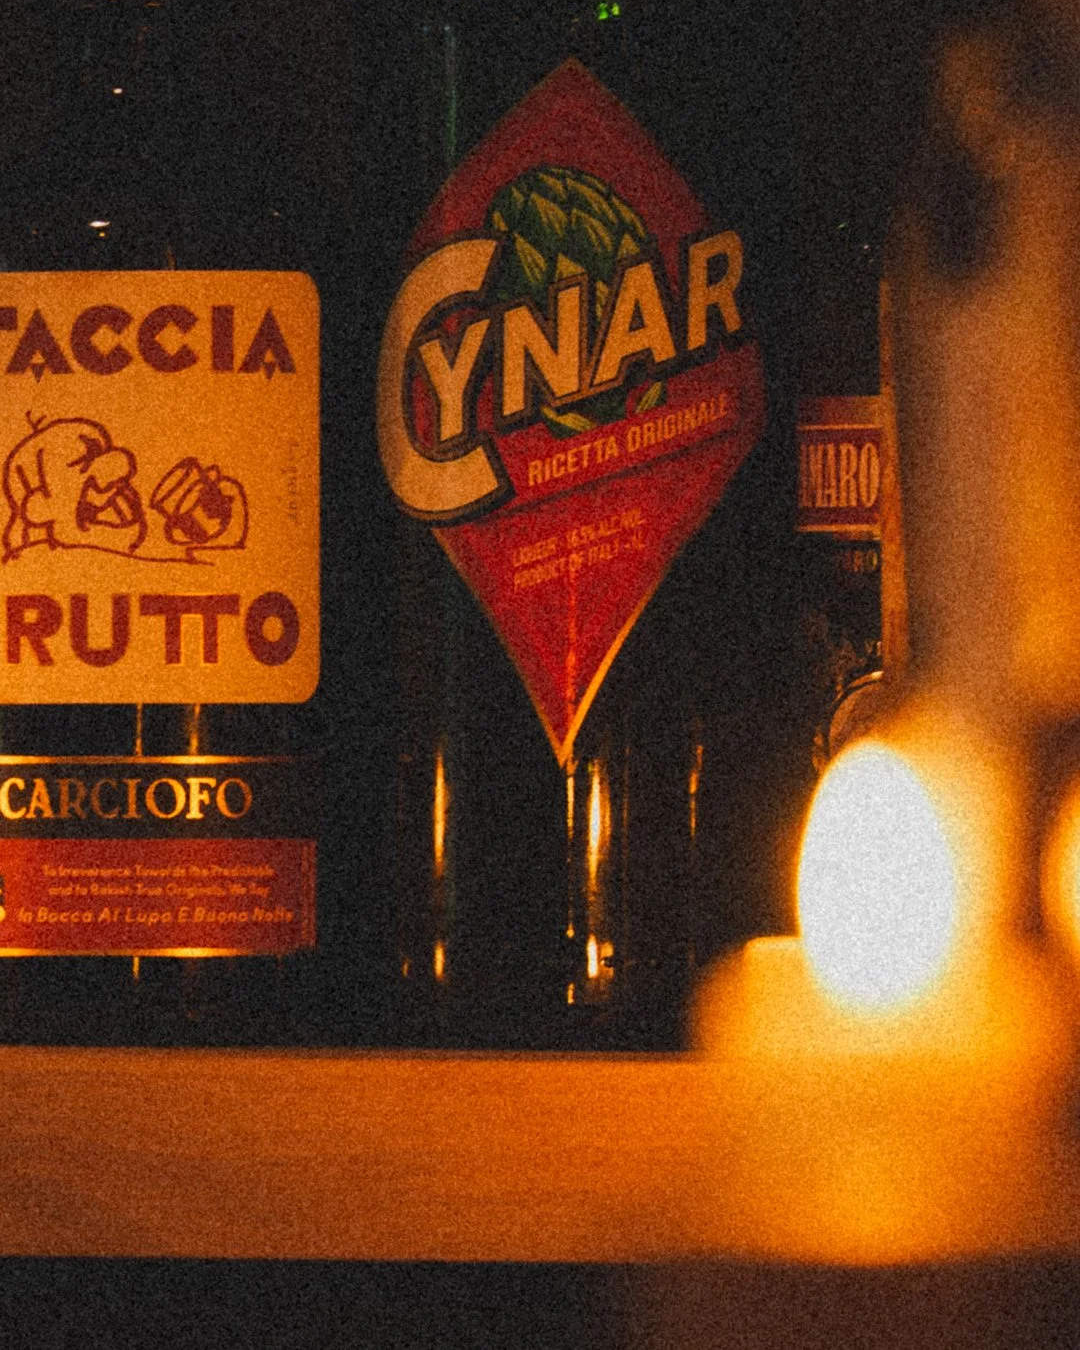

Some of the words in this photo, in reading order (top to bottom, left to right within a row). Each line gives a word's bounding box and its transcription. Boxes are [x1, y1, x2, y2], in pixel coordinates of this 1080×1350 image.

[376, 229, 747, 514] CYNAR
[528, 436, 619, 486] RICETTA
[626, 393, 728, 452] ORIGINALE
[36, 906, 93, 924] Bocca
[177, 906, 189, 923] E
[193, 906, 248, 924] Buona
